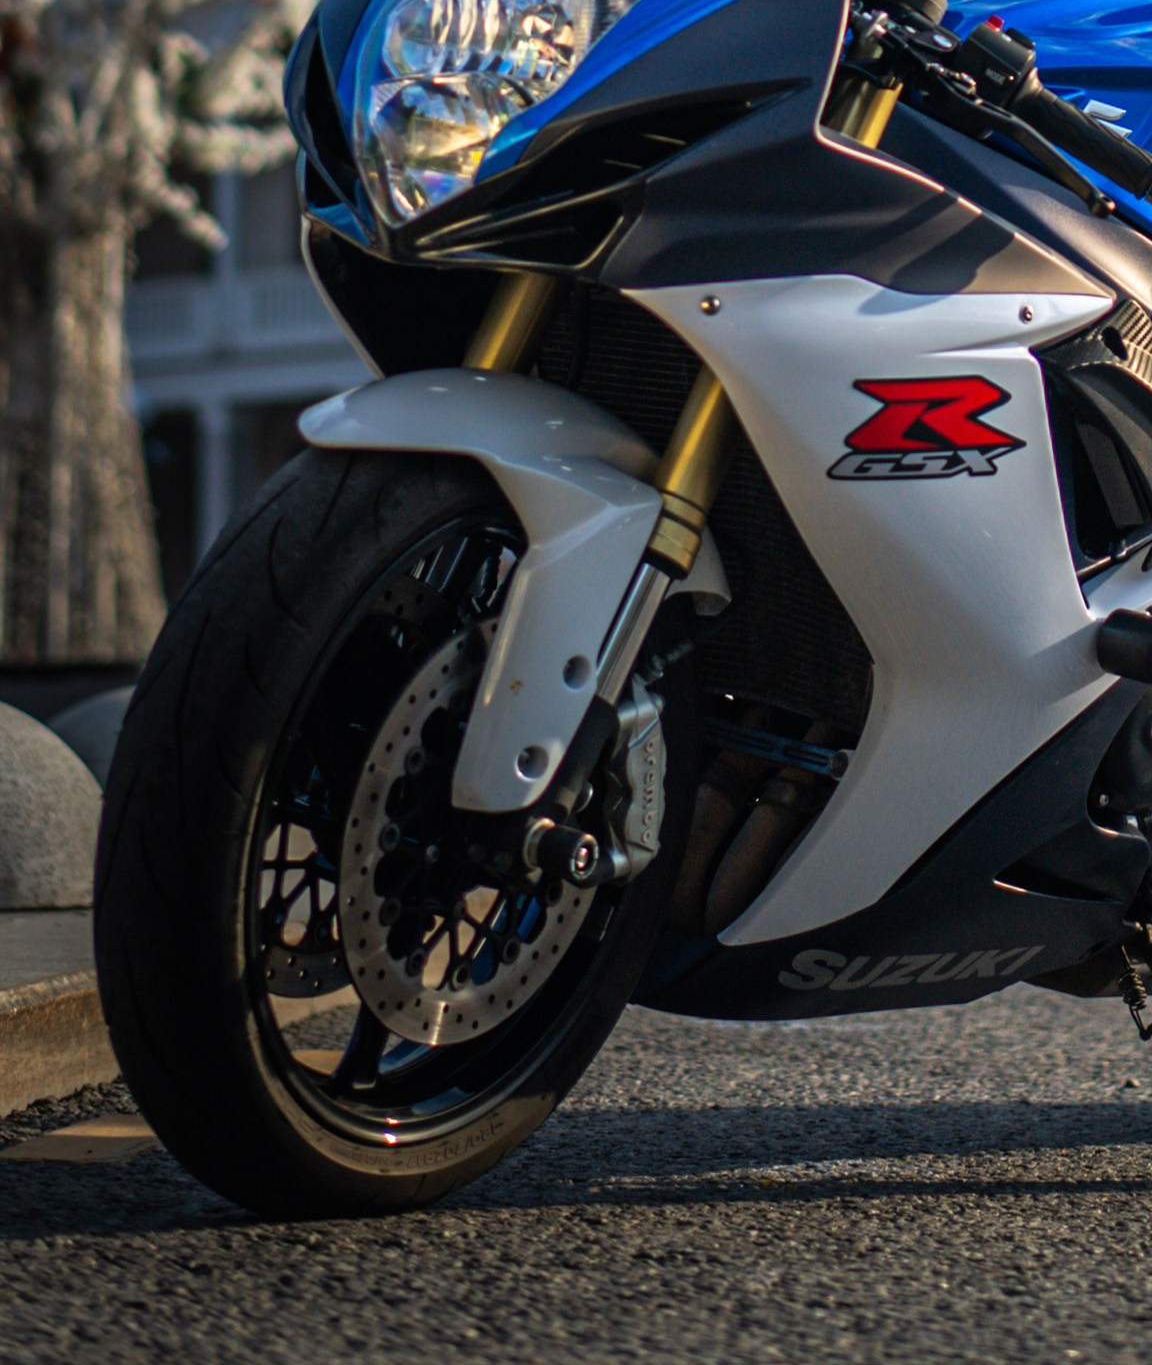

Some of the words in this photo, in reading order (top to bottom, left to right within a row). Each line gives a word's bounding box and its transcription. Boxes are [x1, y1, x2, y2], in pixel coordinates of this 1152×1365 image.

[844, 374, 1027, 452] R
[826, 447, 1018, 480] GSX
[642, 733, 661, 844] brembo
[778, 944, 1046, 991] SUZUKI
